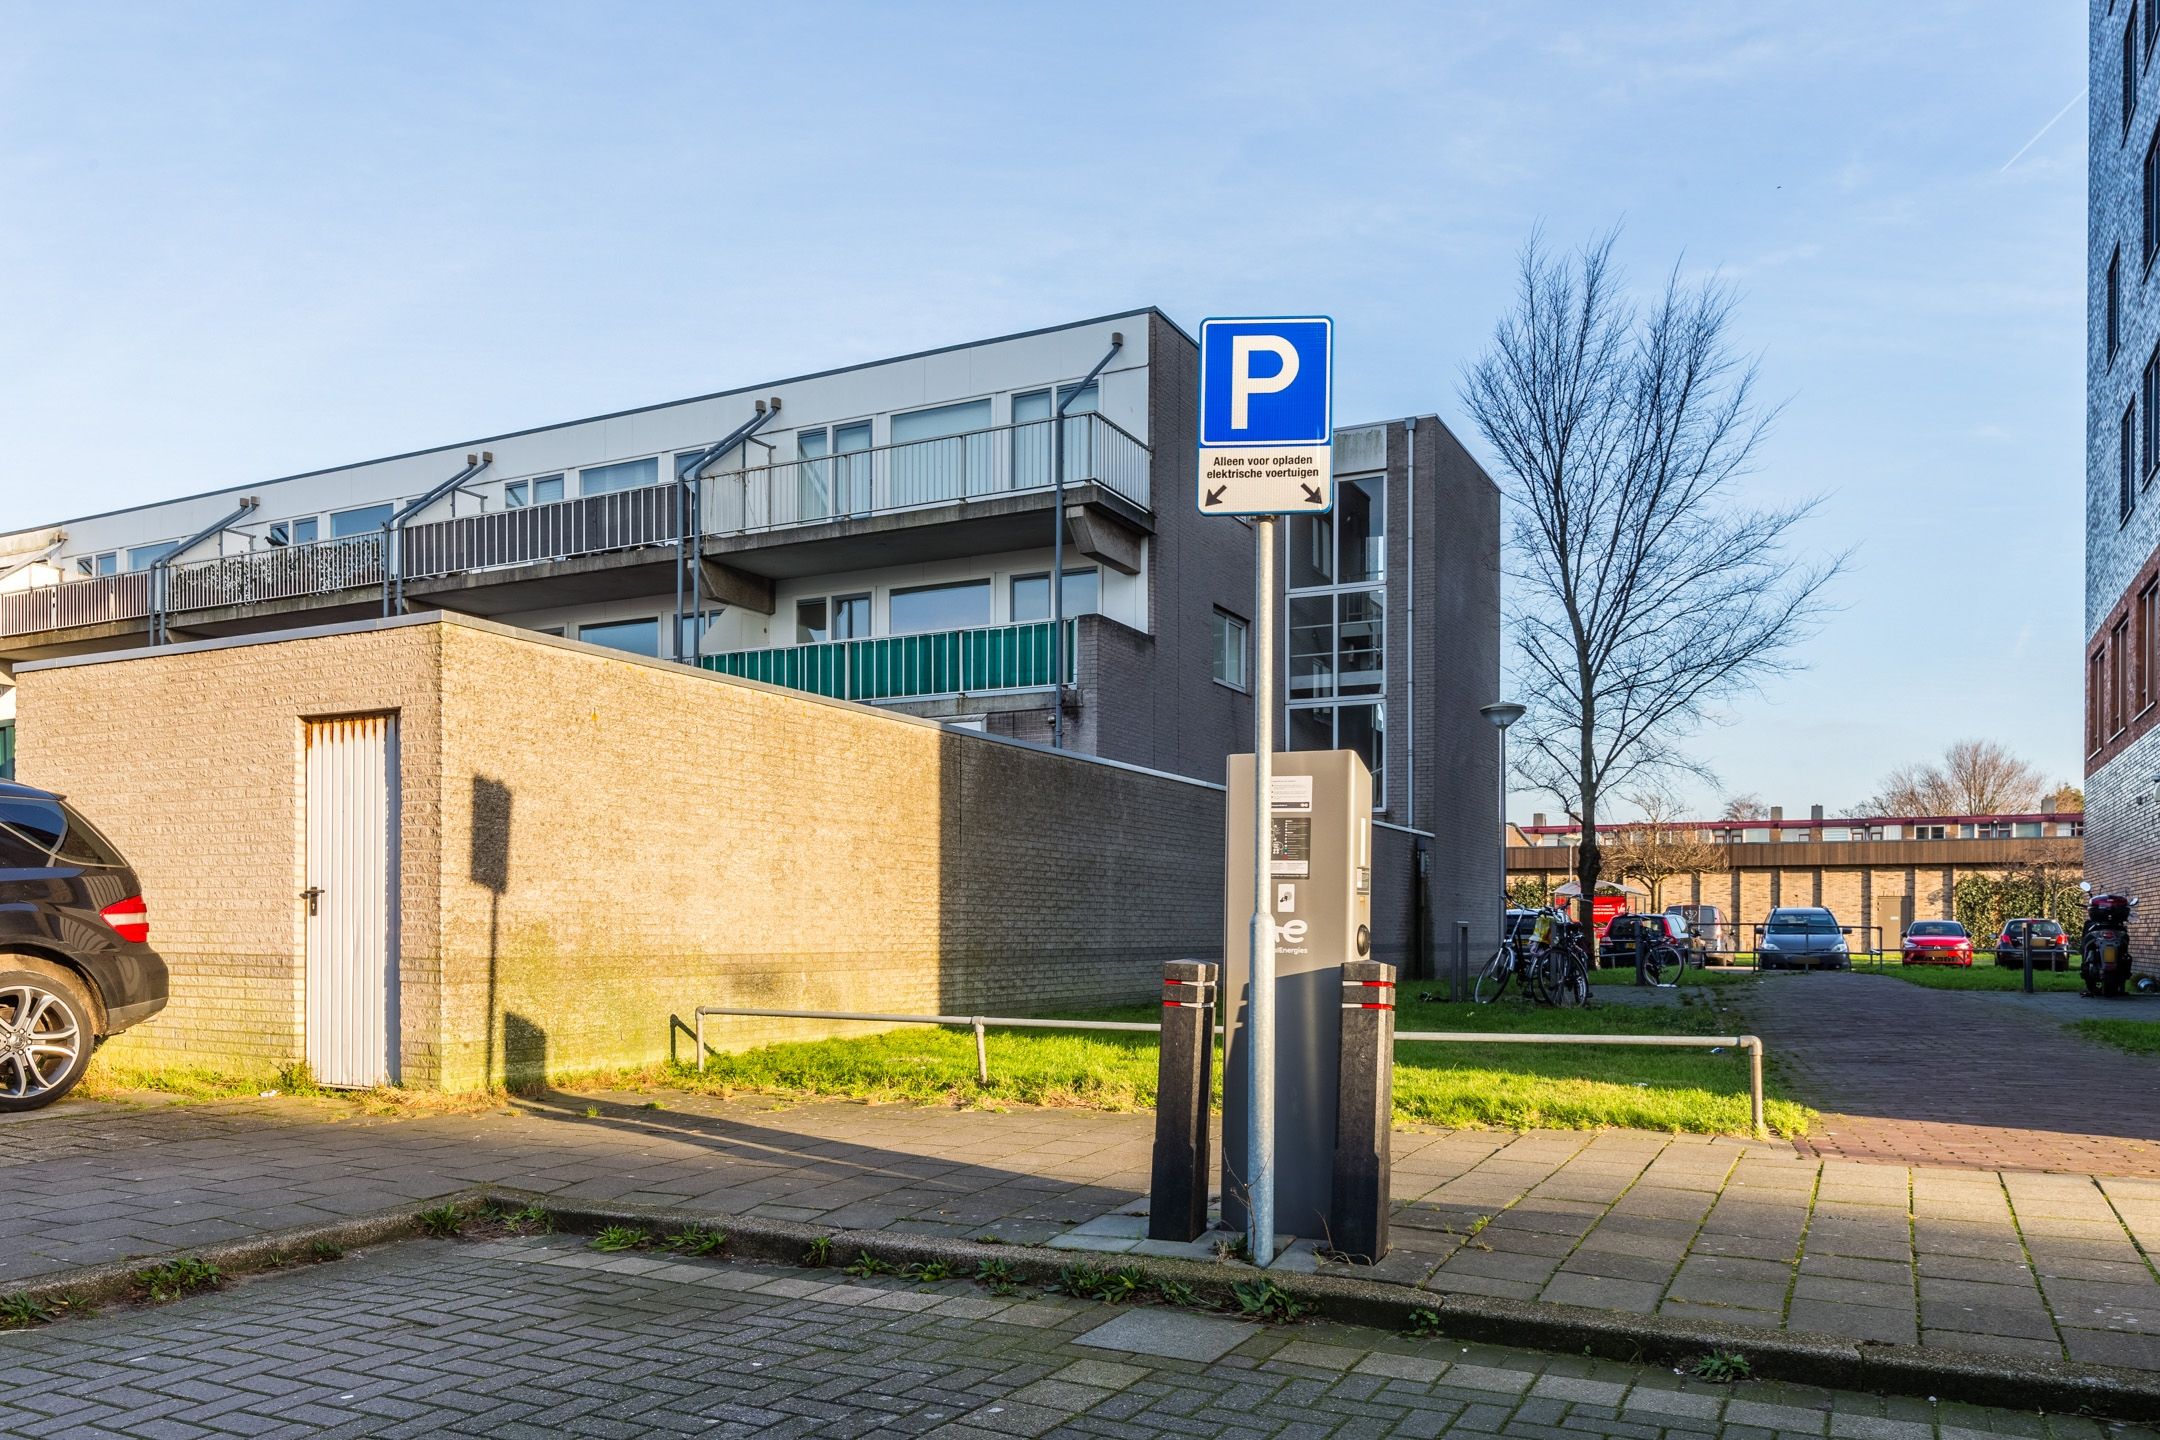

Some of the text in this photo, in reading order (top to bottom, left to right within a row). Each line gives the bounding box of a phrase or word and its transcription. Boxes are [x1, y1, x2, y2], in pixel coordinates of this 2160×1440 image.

[1231, 335, 1300, 430] P
[1213, 455, 1313, 467] Alleen voor opladen
[1206, 467, 1319, 479] elektrische voertuigen
